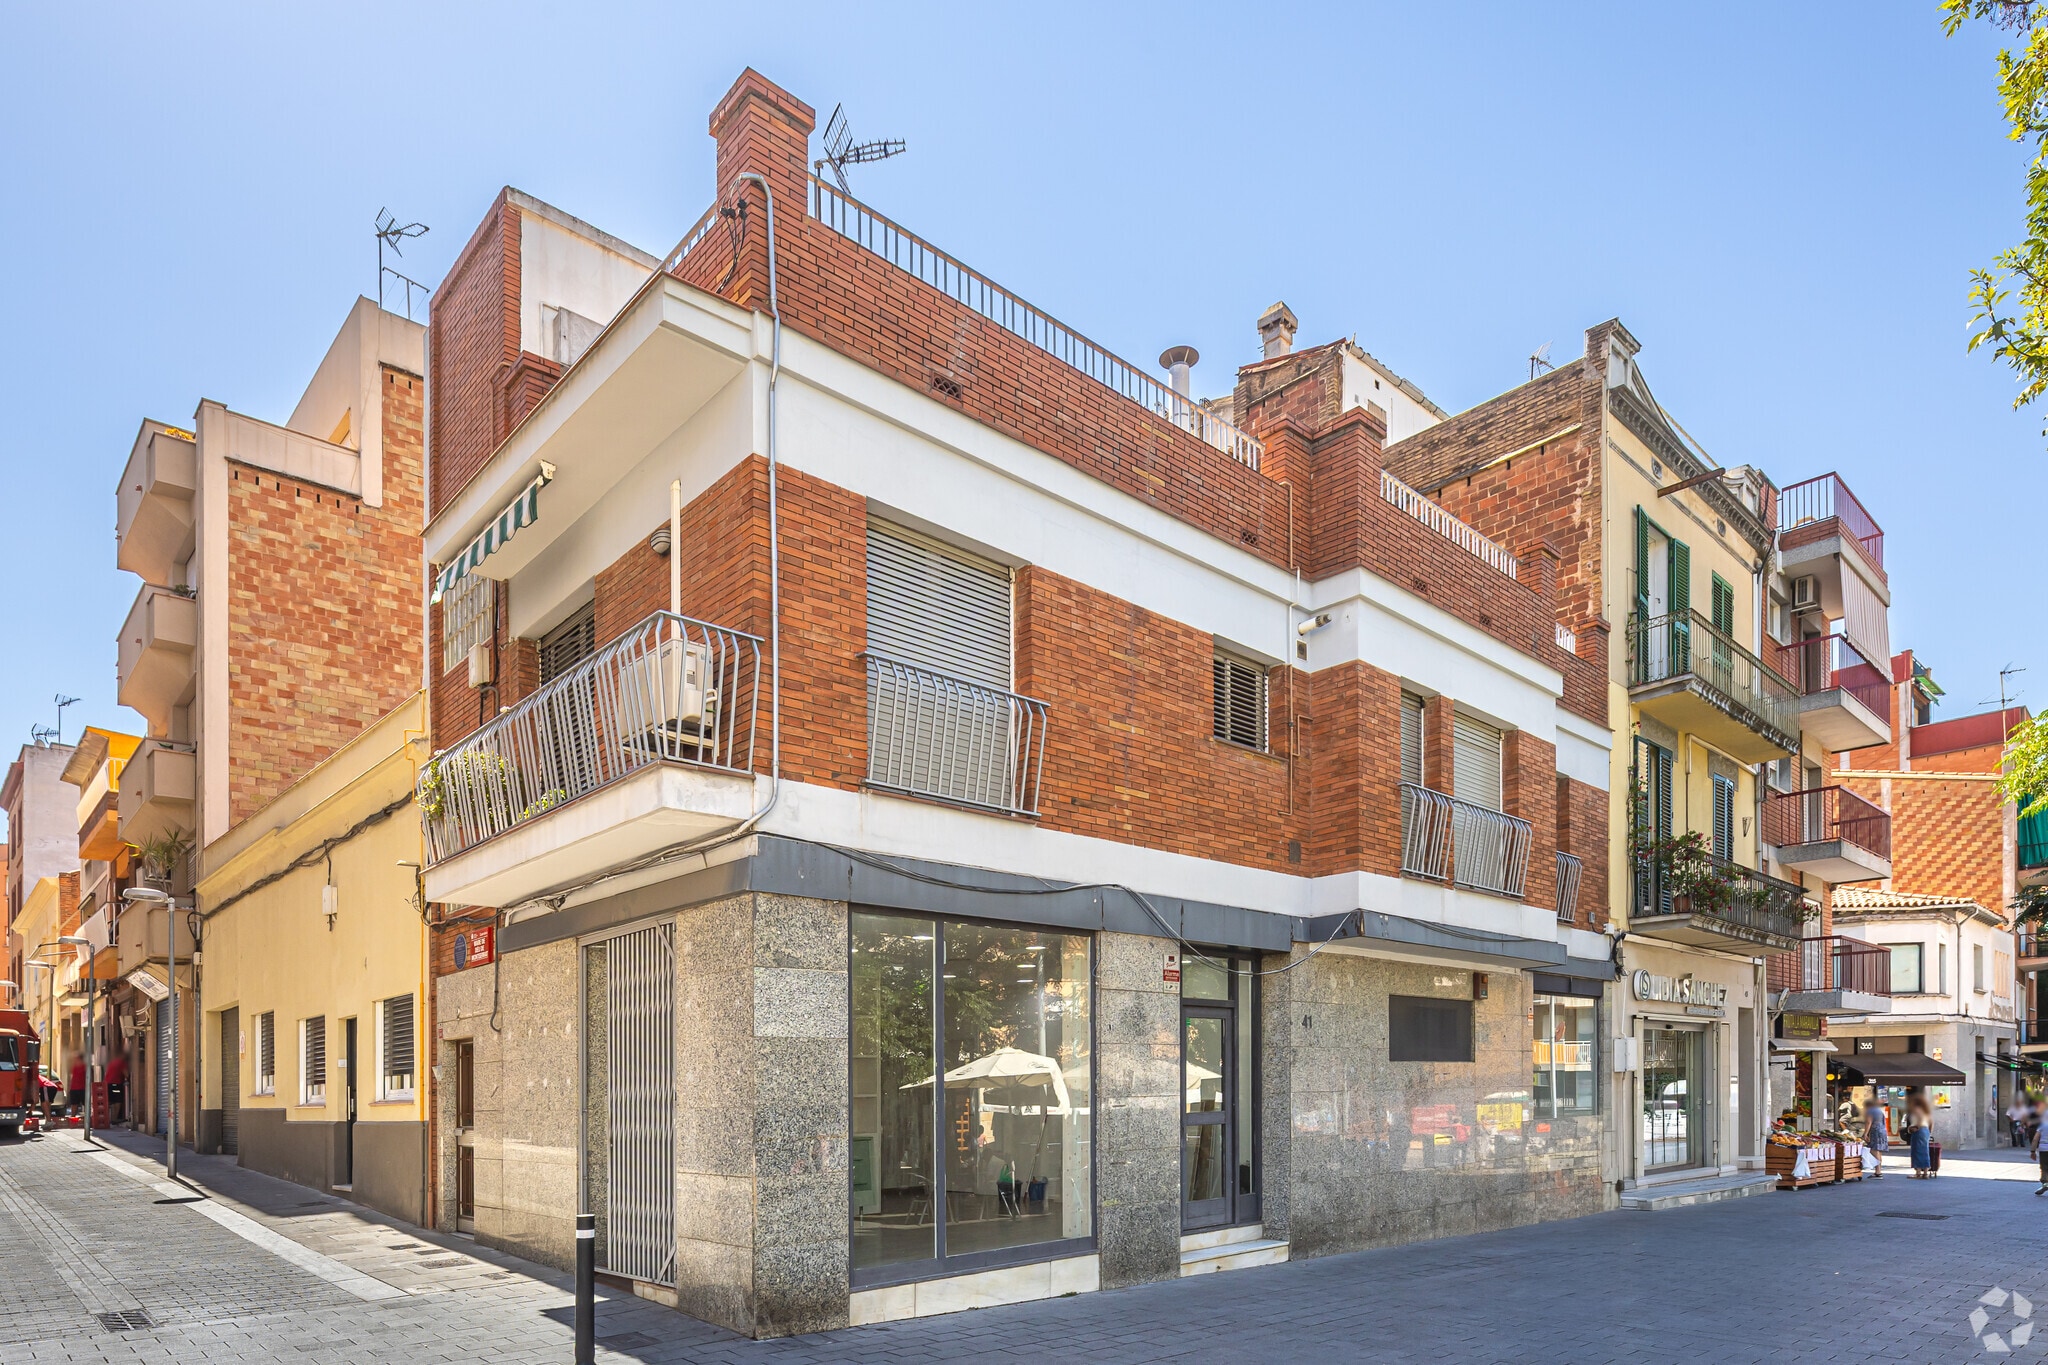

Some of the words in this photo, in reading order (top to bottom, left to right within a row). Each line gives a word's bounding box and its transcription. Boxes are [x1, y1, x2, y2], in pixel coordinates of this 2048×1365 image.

[1651, 975, 1681, 1003] LIDIA
[1301, 1014, 1312, 1029] 41
[1860, 1042, 1872, 1050] 365
